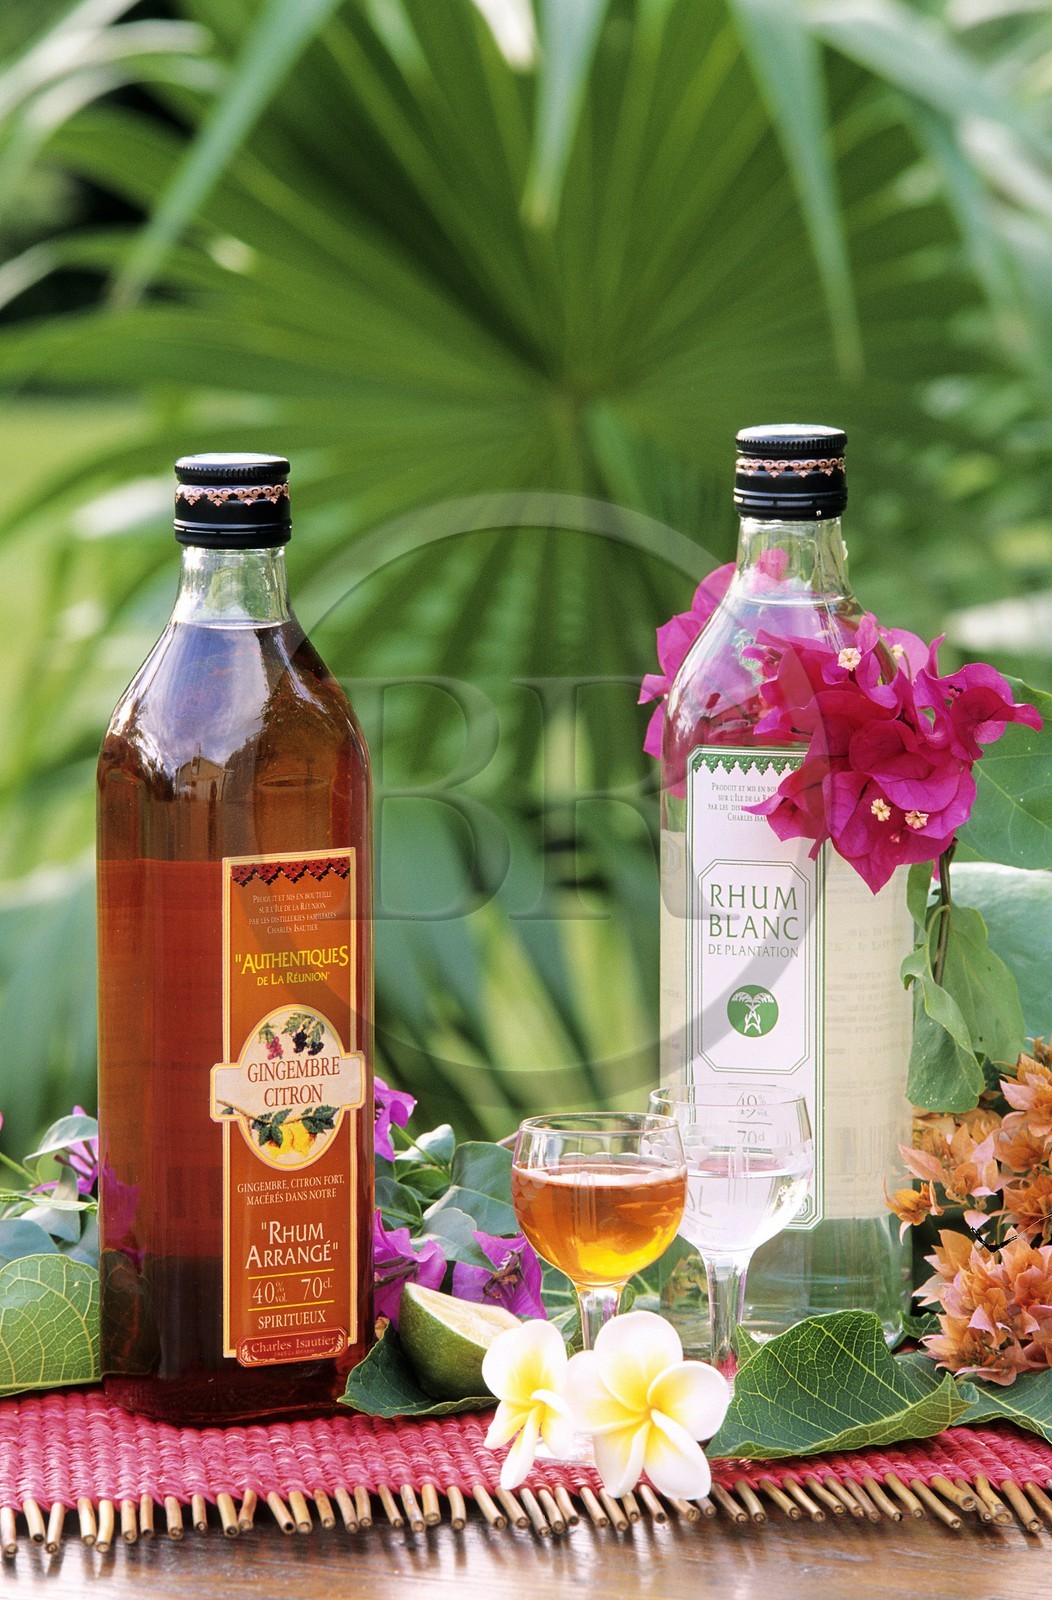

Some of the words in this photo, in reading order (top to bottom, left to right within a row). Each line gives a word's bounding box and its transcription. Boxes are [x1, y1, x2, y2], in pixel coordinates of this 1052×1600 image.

[711, 782, 737, 792] PRODUIT
[738, 784, 745, 792] ET
[757, 785, 766, 793] EN
[718, 794, 730, 802] SUR
[753, 795, 761, 803] LA
[727, 813, 753, 822] CHARLES
[252, 893, 278, 904] PRODUIT
[278, 893, 286, 902] ET
[286, 893, 296, 901] MIS
[304, 890, 332, 900] BOUTEILLE
[709, 883, 798, 911] RHUM
[284, 904, 292, 912] DE
[300, 901, 326, 911] RÉUNION
[249, 917, 259, 925] PAR
[260, 916, 270, 924] LES
[270, 914, 306, 924] DISTILLERIES
[708, 913, 799, 941] BLANC
[267, 925, 292, 935] CHARLES
[293, 923, 319, 933] ISAUTIER
[708, 943, 722, 955] DE
[725, 944, 799, 958] PLANTATION
[256, 975, 269, 987] DE
[271, 973, 285, 986] LA
[247, 1055, 341, 1083] GINGEMBRE
[263, 1083, 324, 1108] CITRON
[237, 1180, 290, 1194] GINGEMBRE,
[290, 1176, 323, 1189] CITRON
[246, 1191, 284, 1206] MACÉRÉS
[285, 1190, 308, 1202] DANS
[309, 1187, 337, 1200] NOTRE
[261, 1220, 325, 1245] "RHUM
[244, 1239, 339, 1270] ARRANGÉ"
[252, 1280, 276, 1304] 40
[275, 1281, 285, 1293] %
[258, 1309, 327, 1330] SPIRITUEUX
[251, 1339, 292, 1353] Charles
[295, 1334, 337, 1349] Isautier
